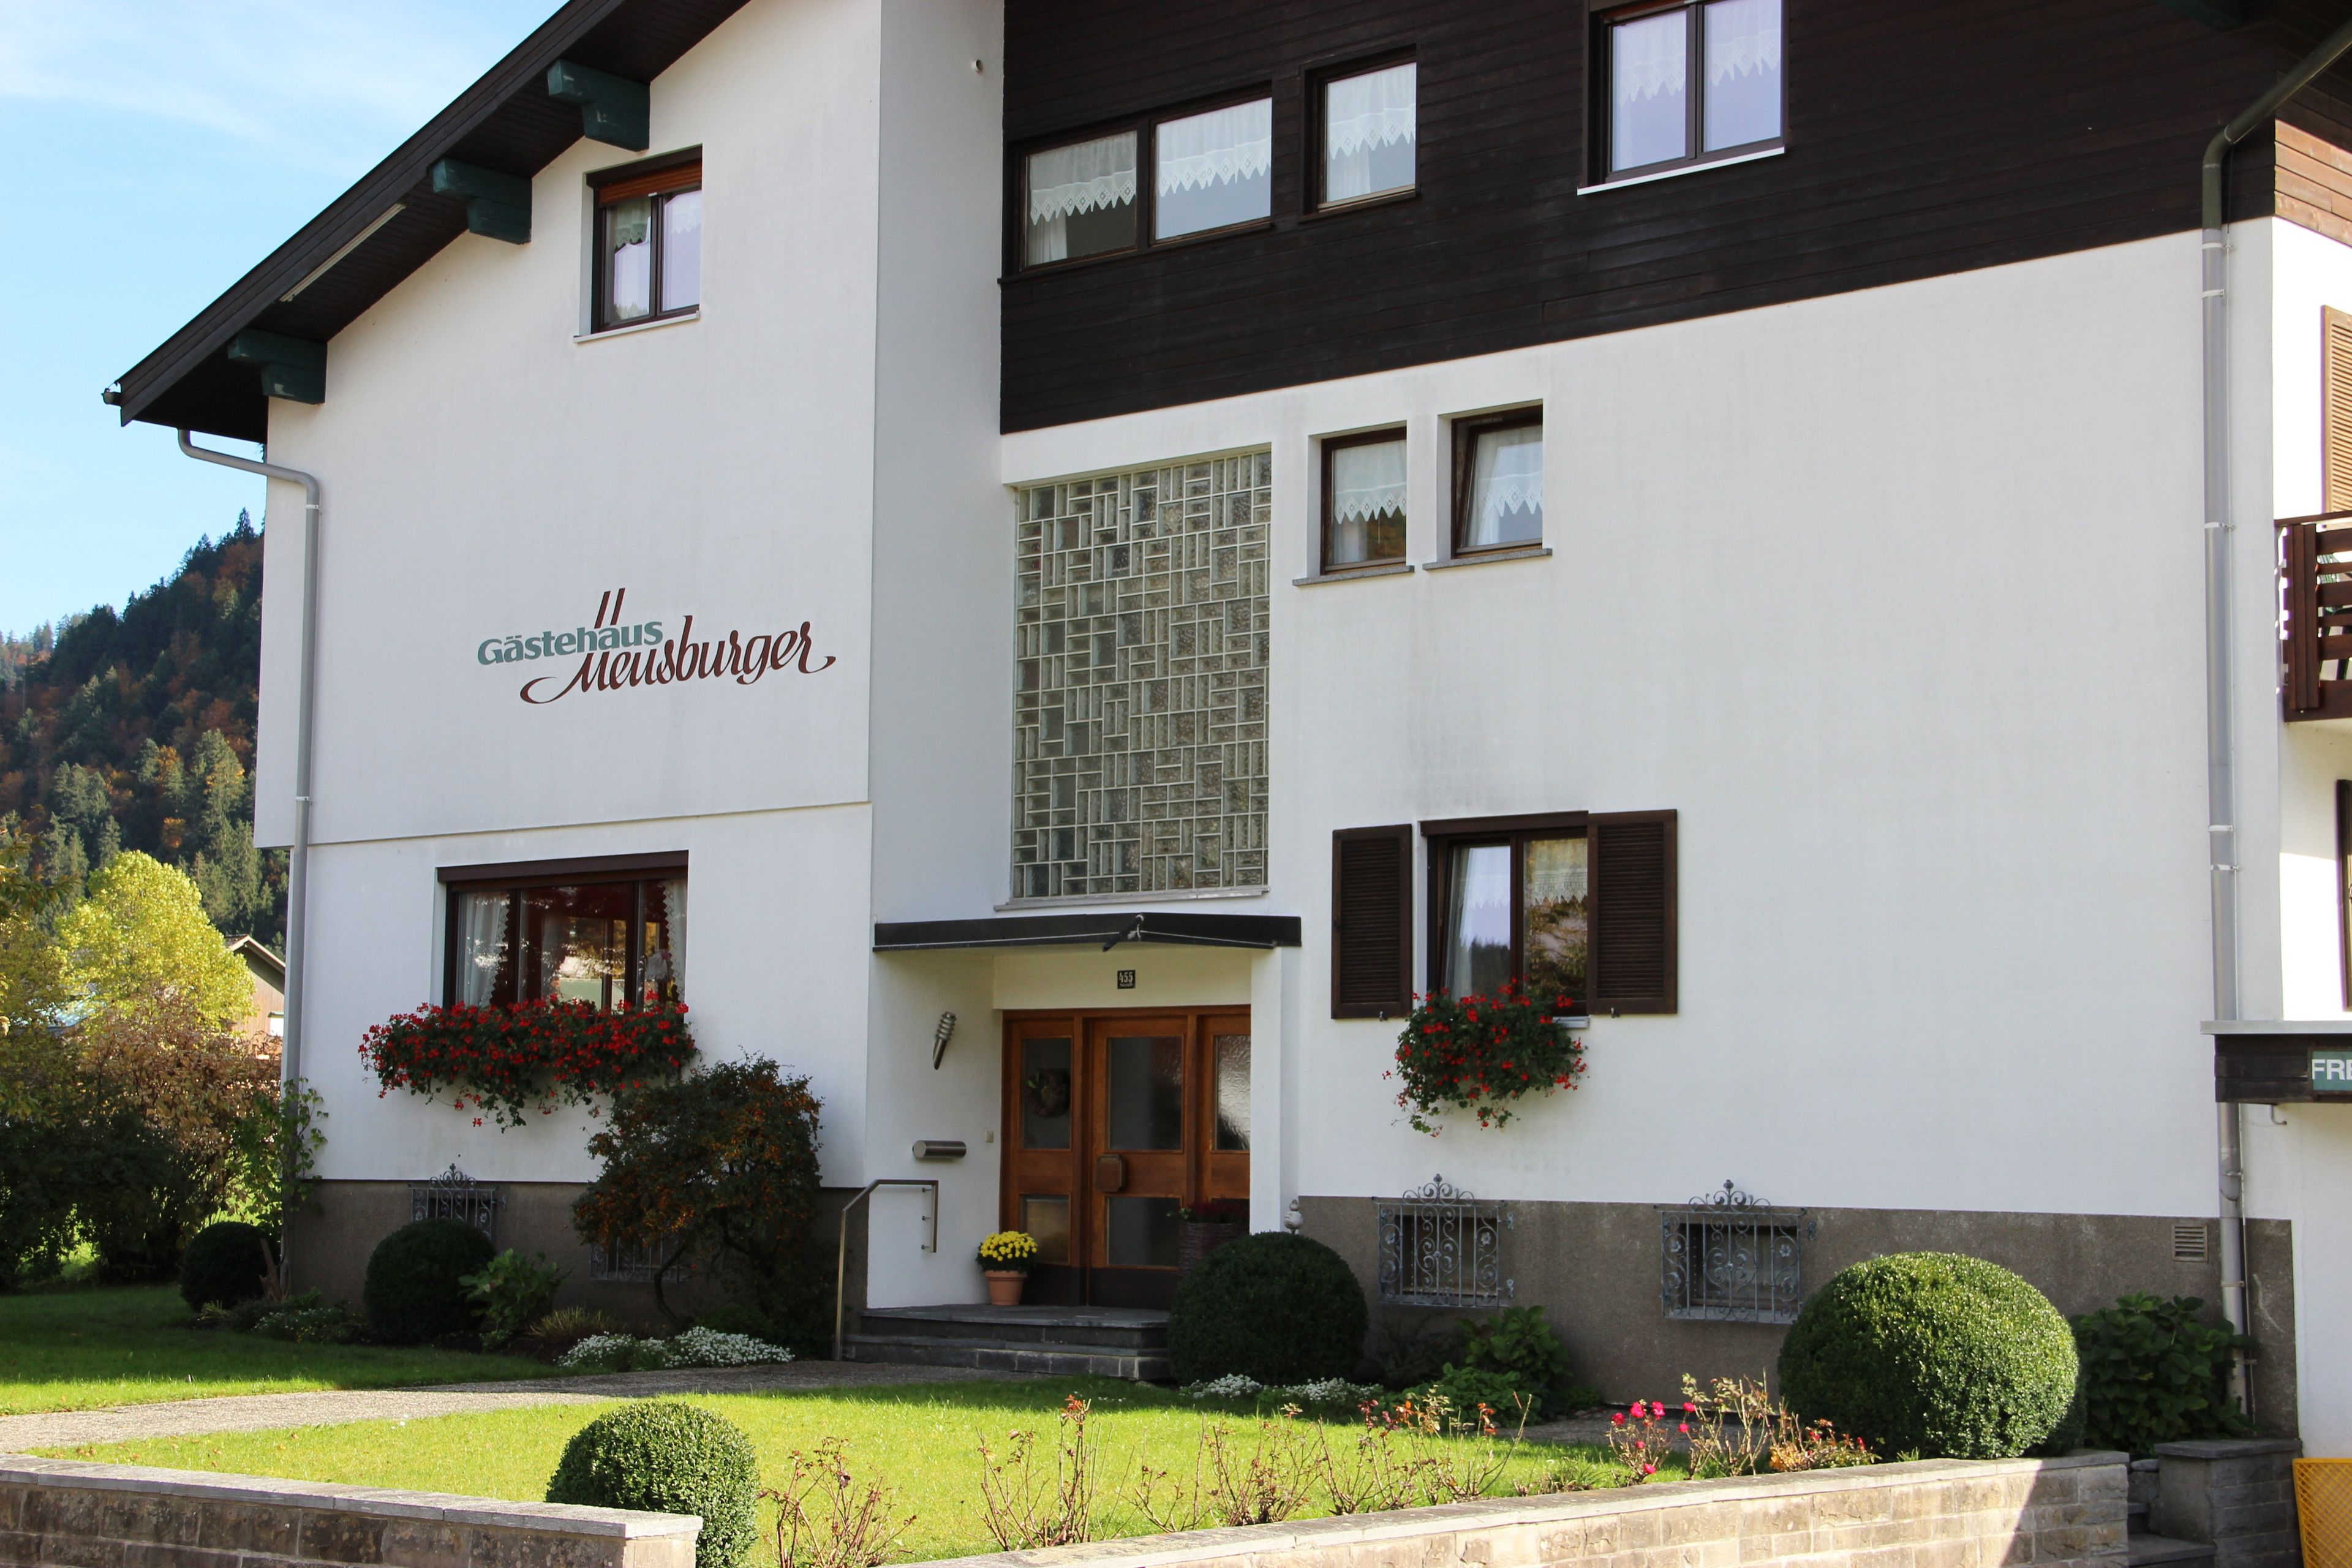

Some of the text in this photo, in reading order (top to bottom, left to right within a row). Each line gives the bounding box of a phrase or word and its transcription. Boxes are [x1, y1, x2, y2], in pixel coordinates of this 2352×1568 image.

[477, 620, 663, 666] Gästehaus
[519, 587, 837, 704] Meusburger
[1119, 971, 1133, 983] 455
